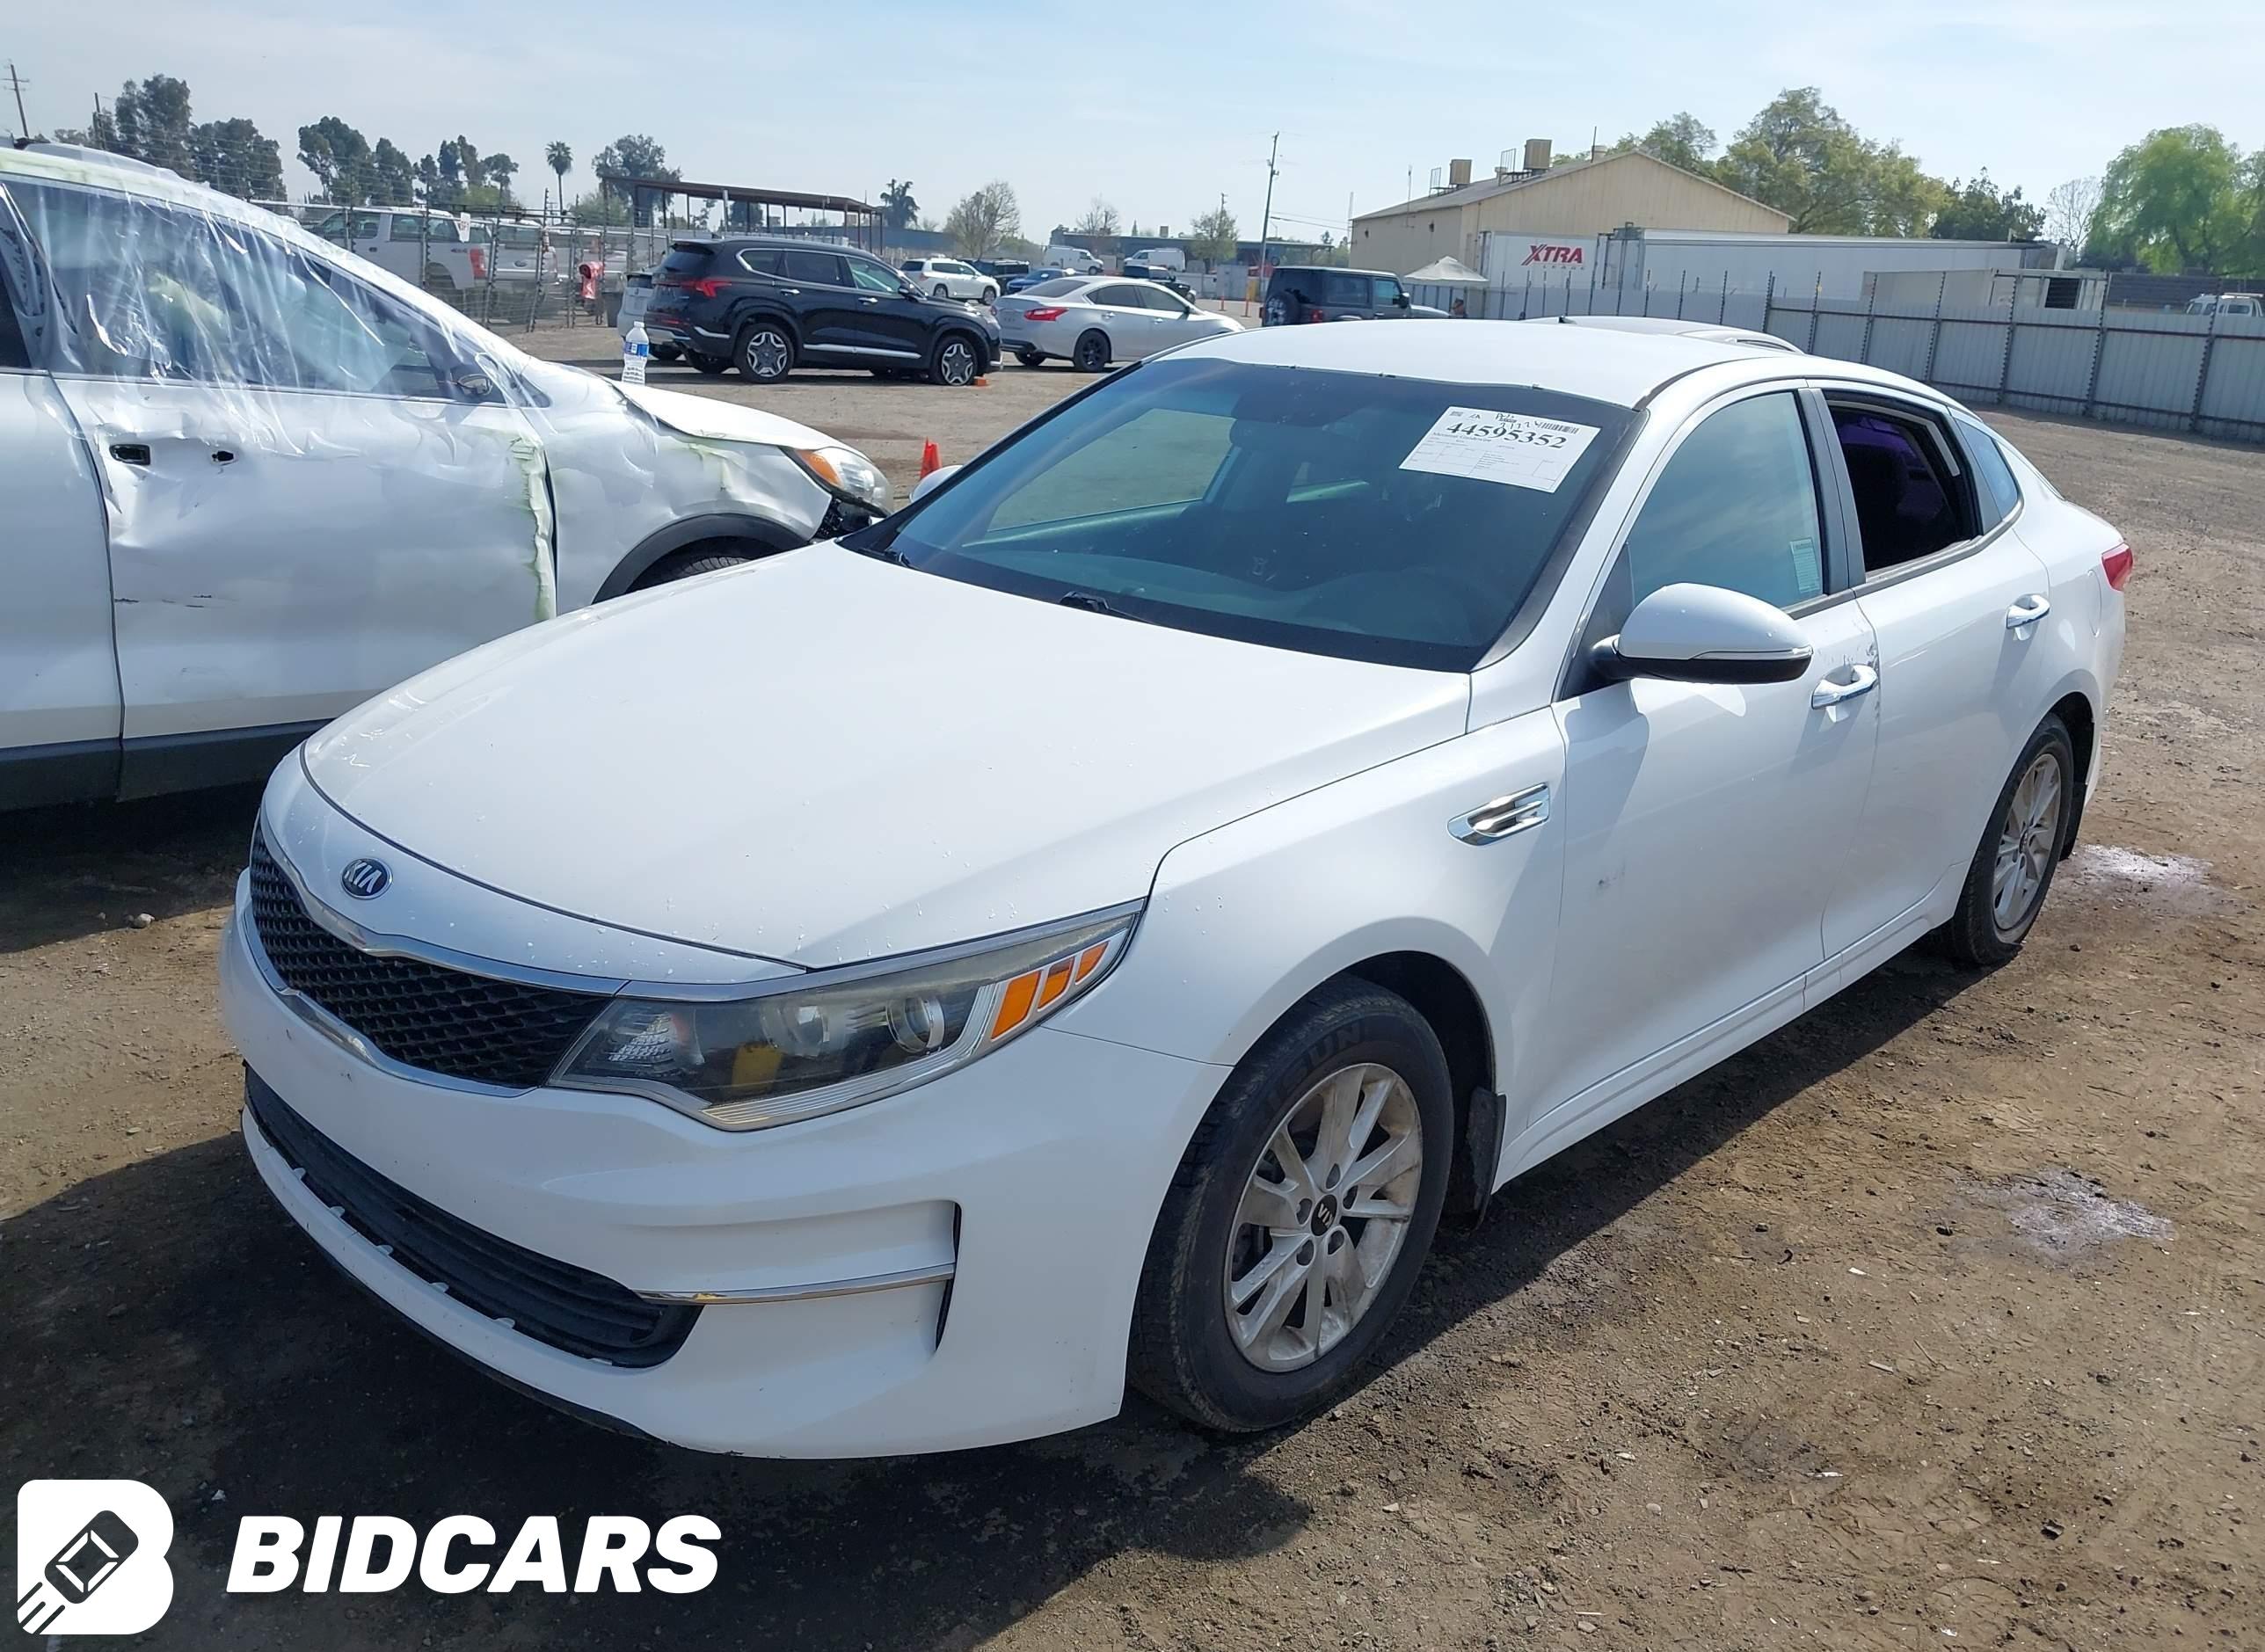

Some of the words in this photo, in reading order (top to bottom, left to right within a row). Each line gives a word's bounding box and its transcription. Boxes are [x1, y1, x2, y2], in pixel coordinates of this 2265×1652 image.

[1520, 244, 1584, 266] XTRA
[1446, 422, 1568, 449] 44595352
[344, 859, 382, 893] KIA
